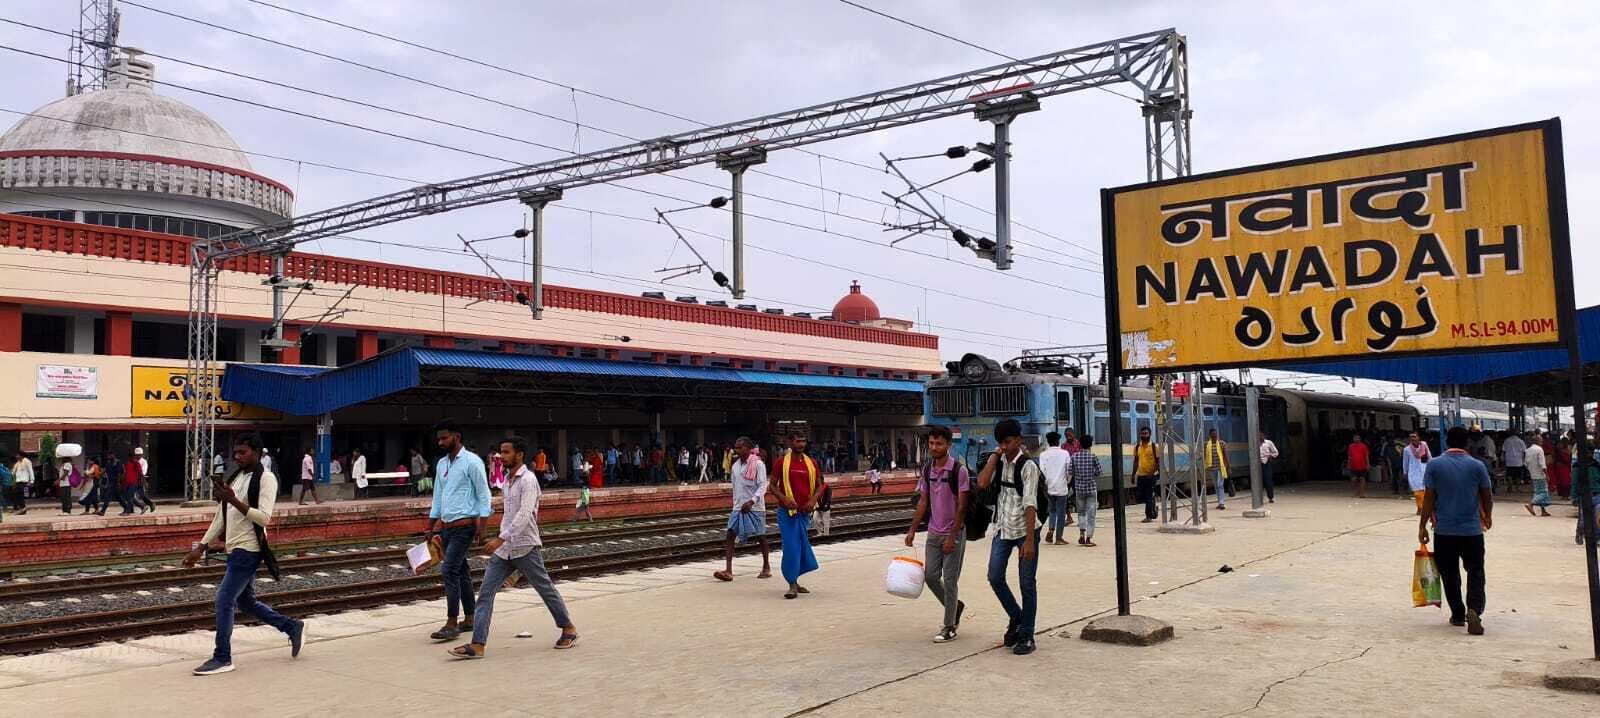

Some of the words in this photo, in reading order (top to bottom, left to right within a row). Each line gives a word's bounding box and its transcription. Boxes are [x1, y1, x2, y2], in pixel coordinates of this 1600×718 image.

[1160, 161, 1477, 246] नवादा
[1135, 224, 1524, 308] NAWADAH
[145, 389, 223, 401] NAWA
